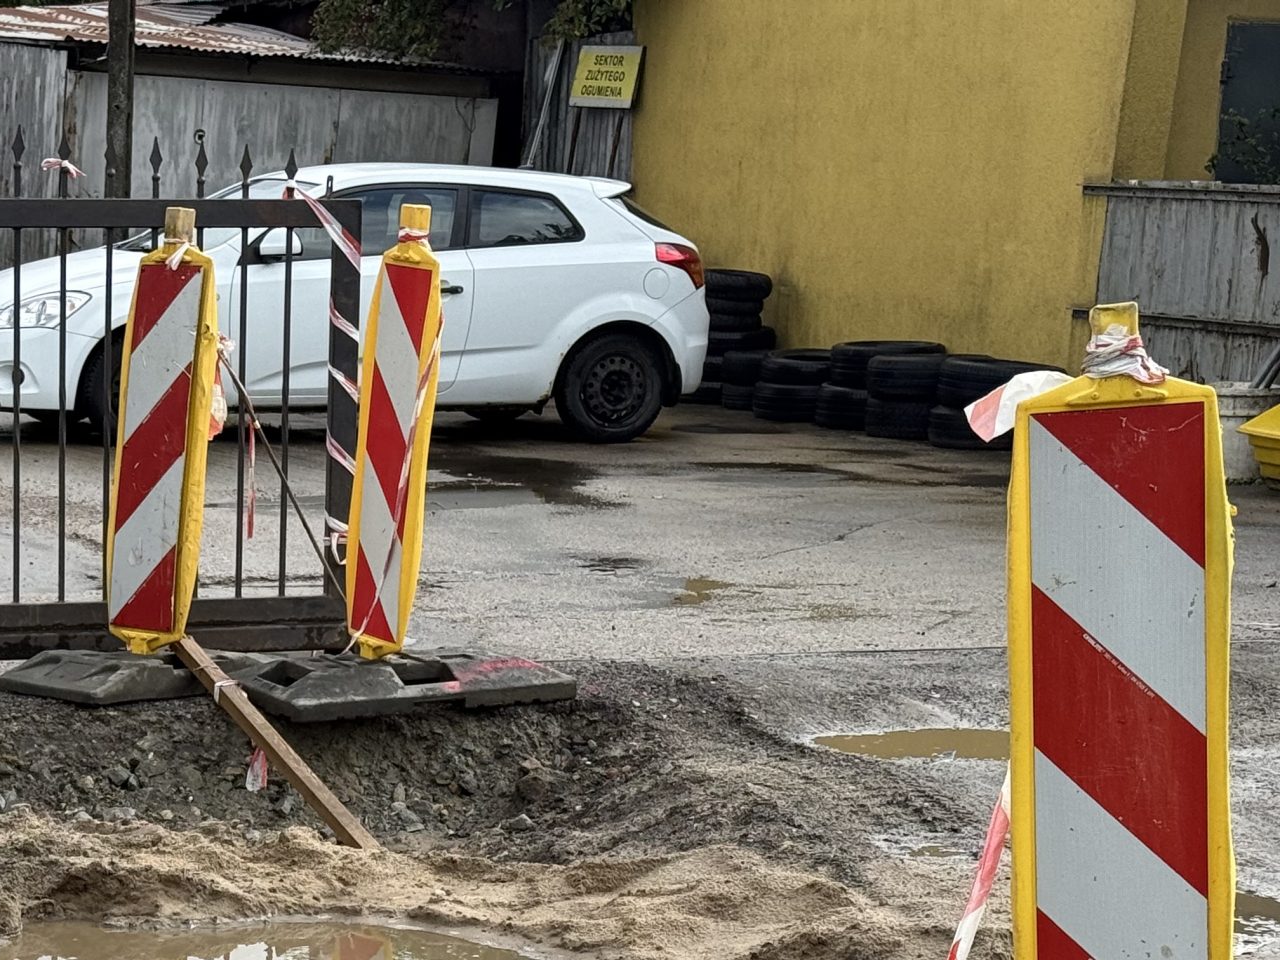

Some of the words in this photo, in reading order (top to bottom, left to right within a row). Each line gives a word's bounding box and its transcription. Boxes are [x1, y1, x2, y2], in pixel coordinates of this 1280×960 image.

[593, 54, 625, 66] SEKTOR
[585, 68, 626, 82] ZUŻYTEGO
[580, 84, 623, 97] OGUMIENIA
